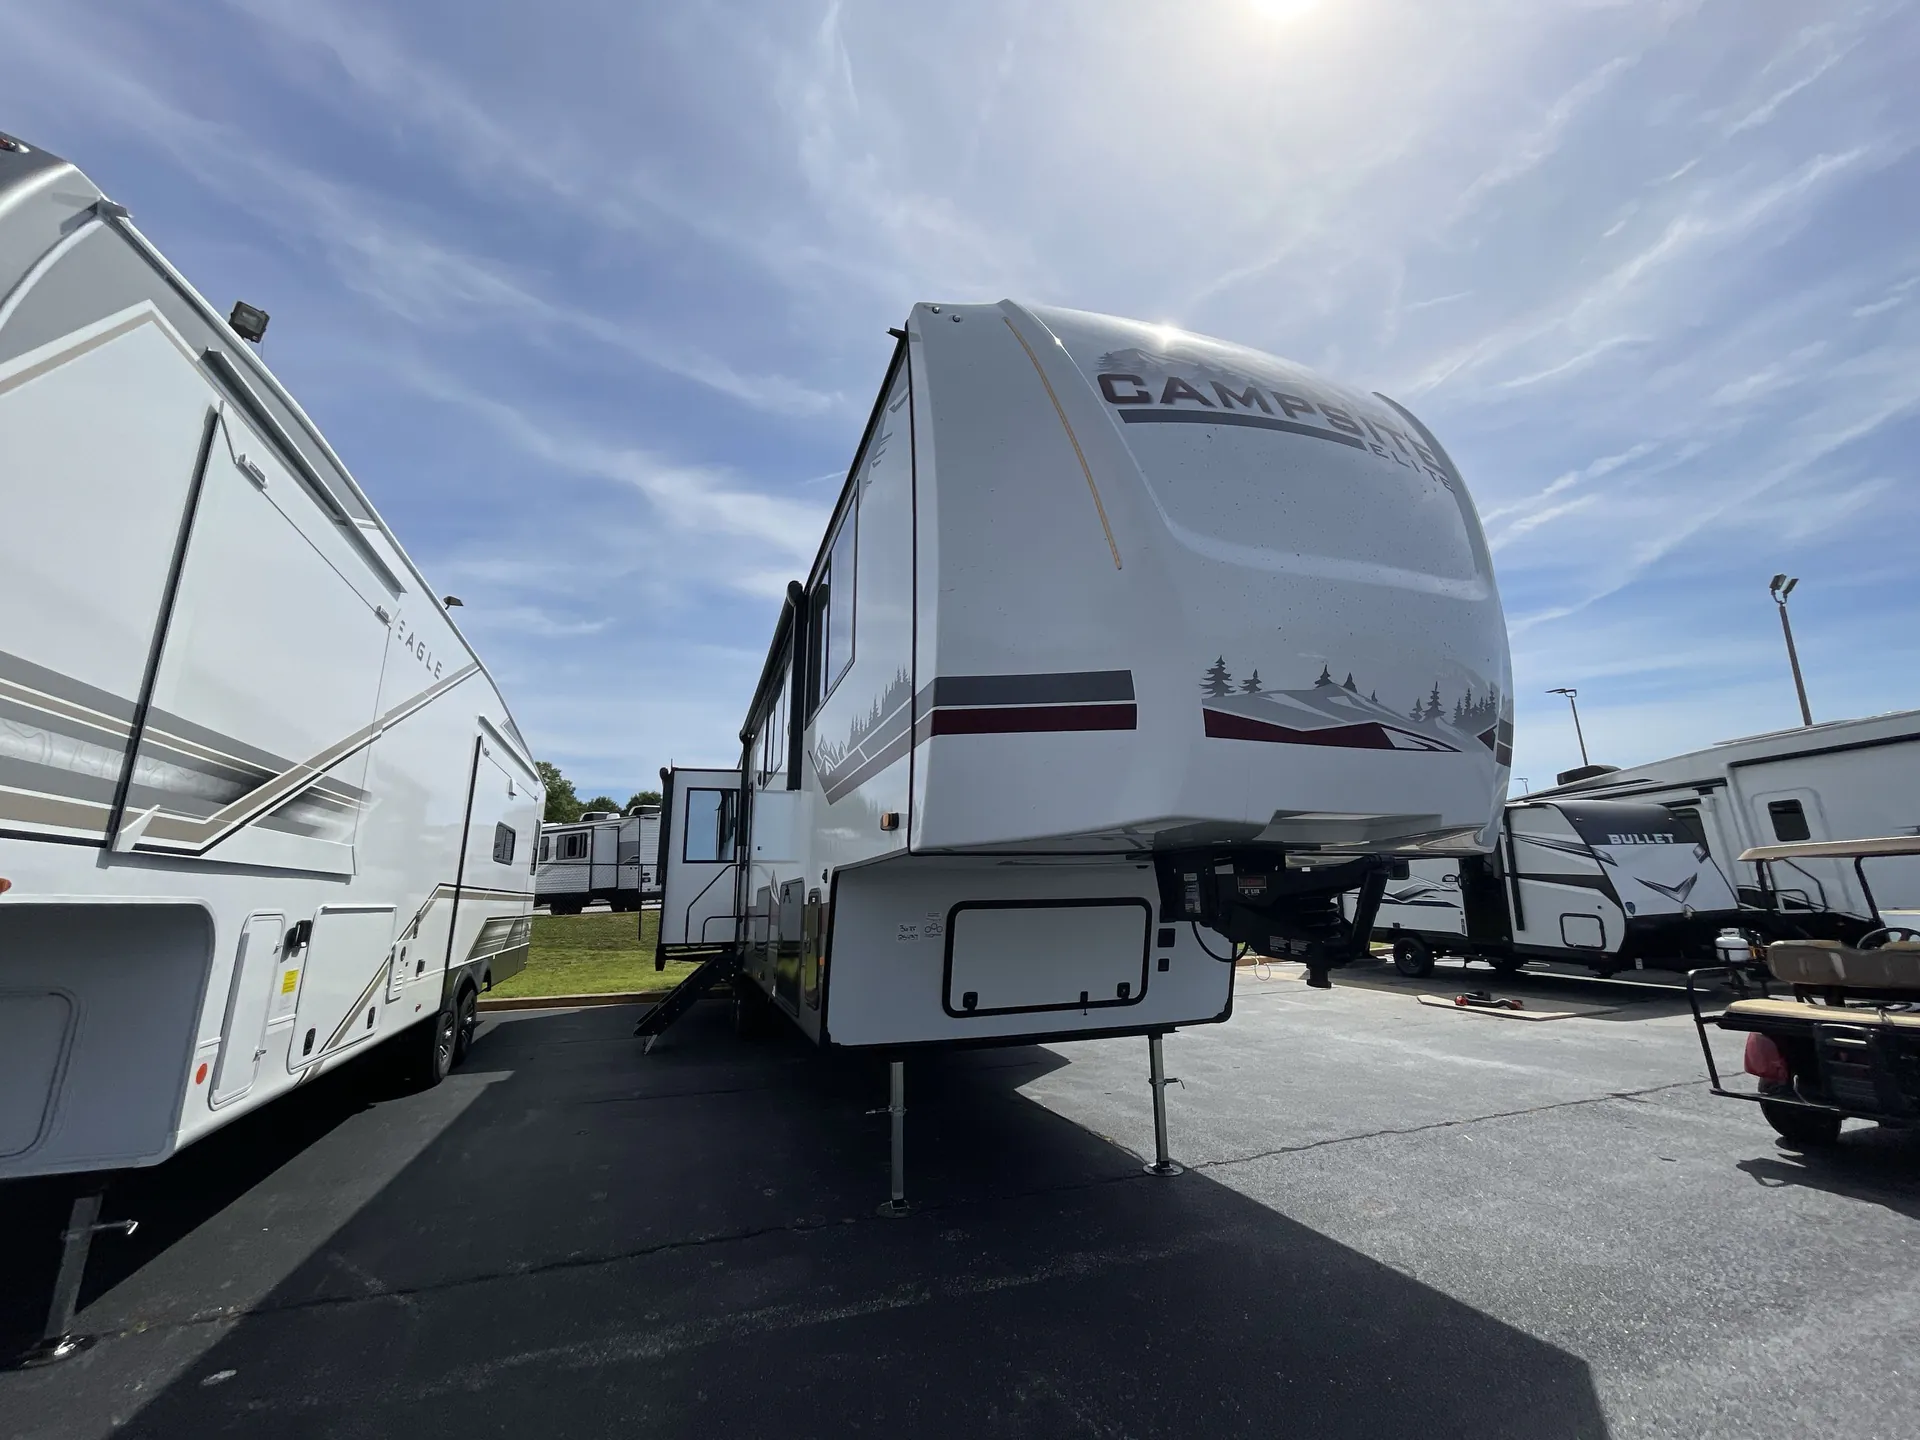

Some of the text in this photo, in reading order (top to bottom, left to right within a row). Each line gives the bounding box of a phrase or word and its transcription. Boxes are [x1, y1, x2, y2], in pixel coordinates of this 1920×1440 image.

[1097, 373, 1450, 480] CAMPSITE
[1367, 441, 1455, 494] ELITE
[398, 620, 442, 680] EAGLE
[1607, 833, 1674, 845] BULLET
